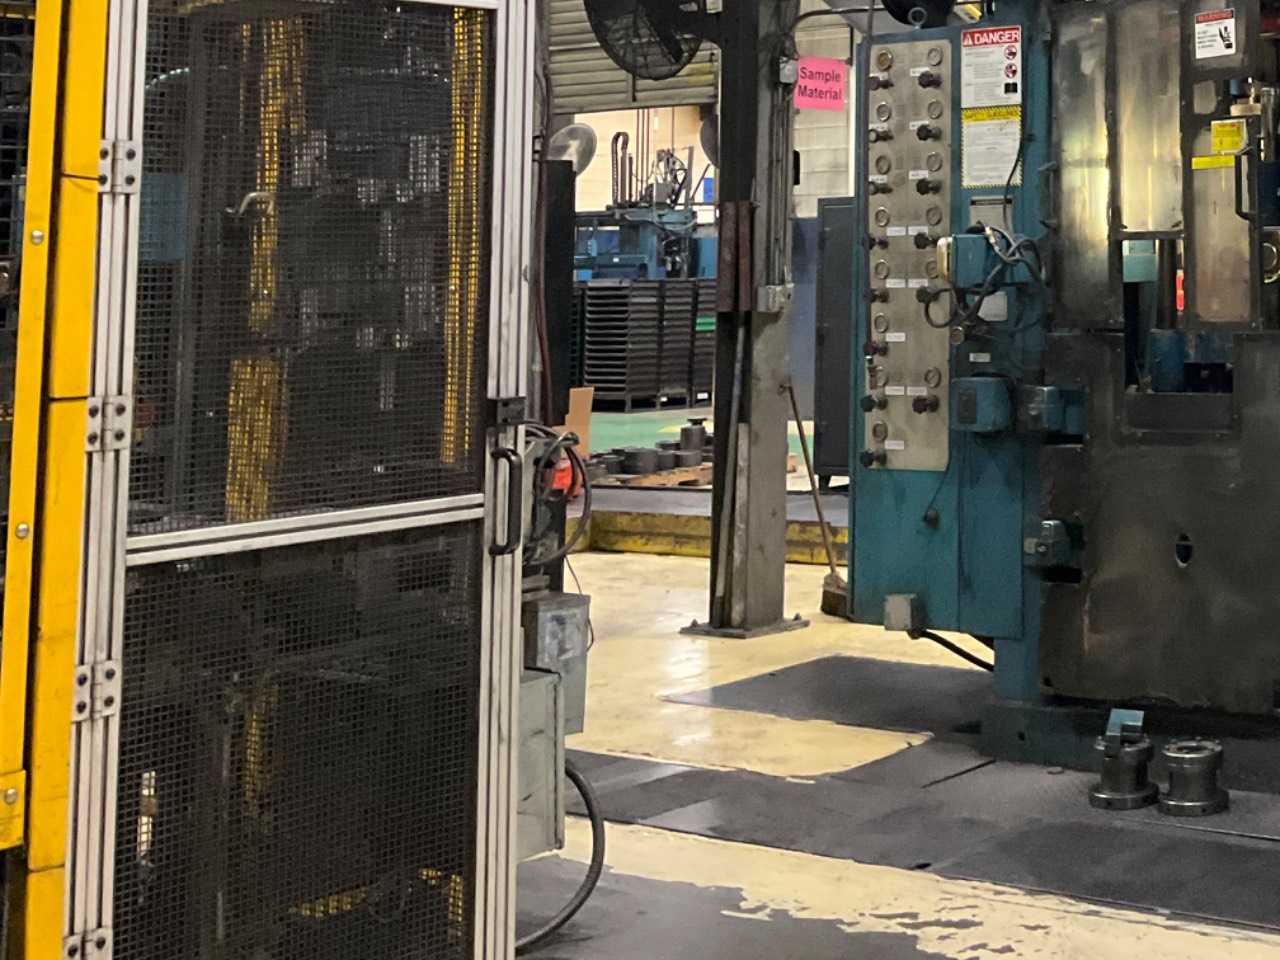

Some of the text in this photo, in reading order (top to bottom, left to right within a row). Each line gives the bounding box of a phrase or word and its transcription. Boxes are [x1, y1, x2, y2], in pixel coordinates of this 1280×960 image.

[974, 30, 1019, 44] DANGER
[799, 66, 841, 83] Sample
[797, 84, 842, 100] Material
